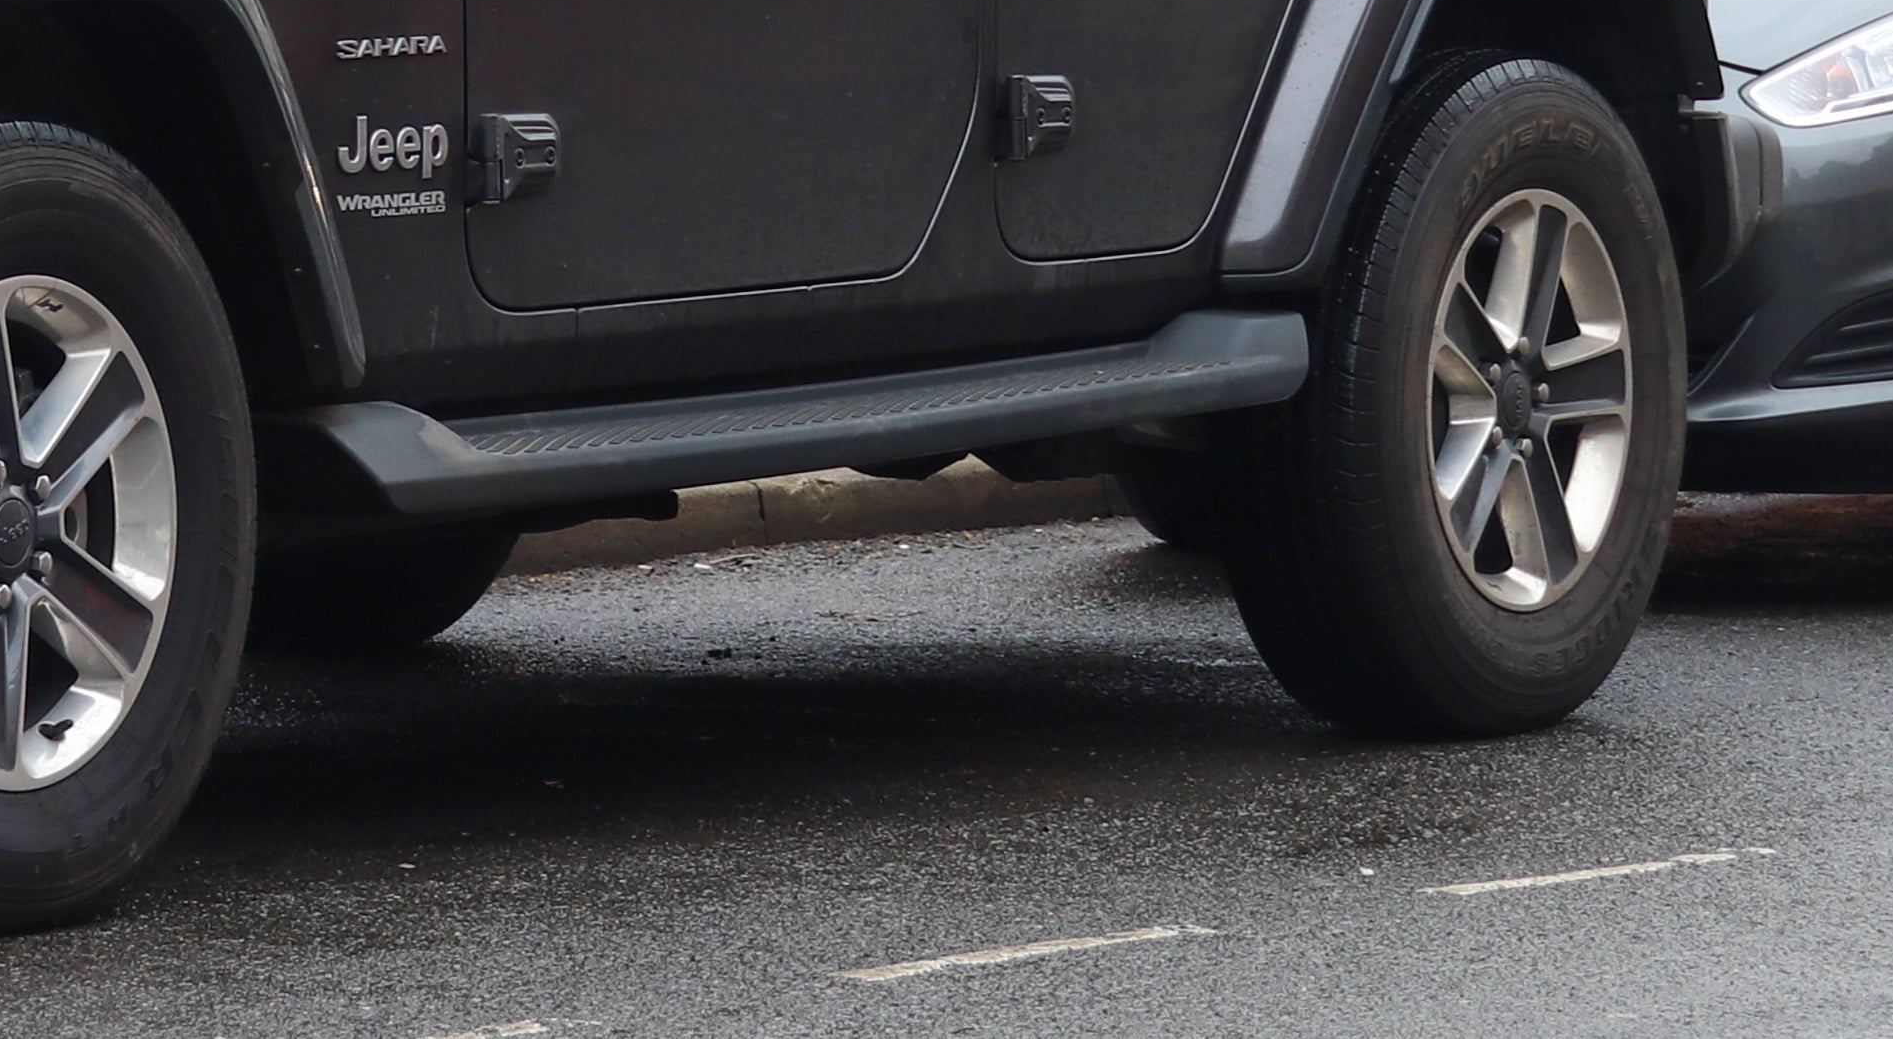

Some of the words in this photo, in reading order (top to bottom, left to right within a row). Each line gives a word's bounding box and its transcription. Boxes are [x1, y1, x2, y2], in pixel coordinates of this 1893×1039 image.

[336, 35, 447, 59] SAHARA
[337, 115, 448, 179] Jeep
[336, 191, 445, 211] WRANGLER
[371, 205, 446, 217] UNLIMITED
